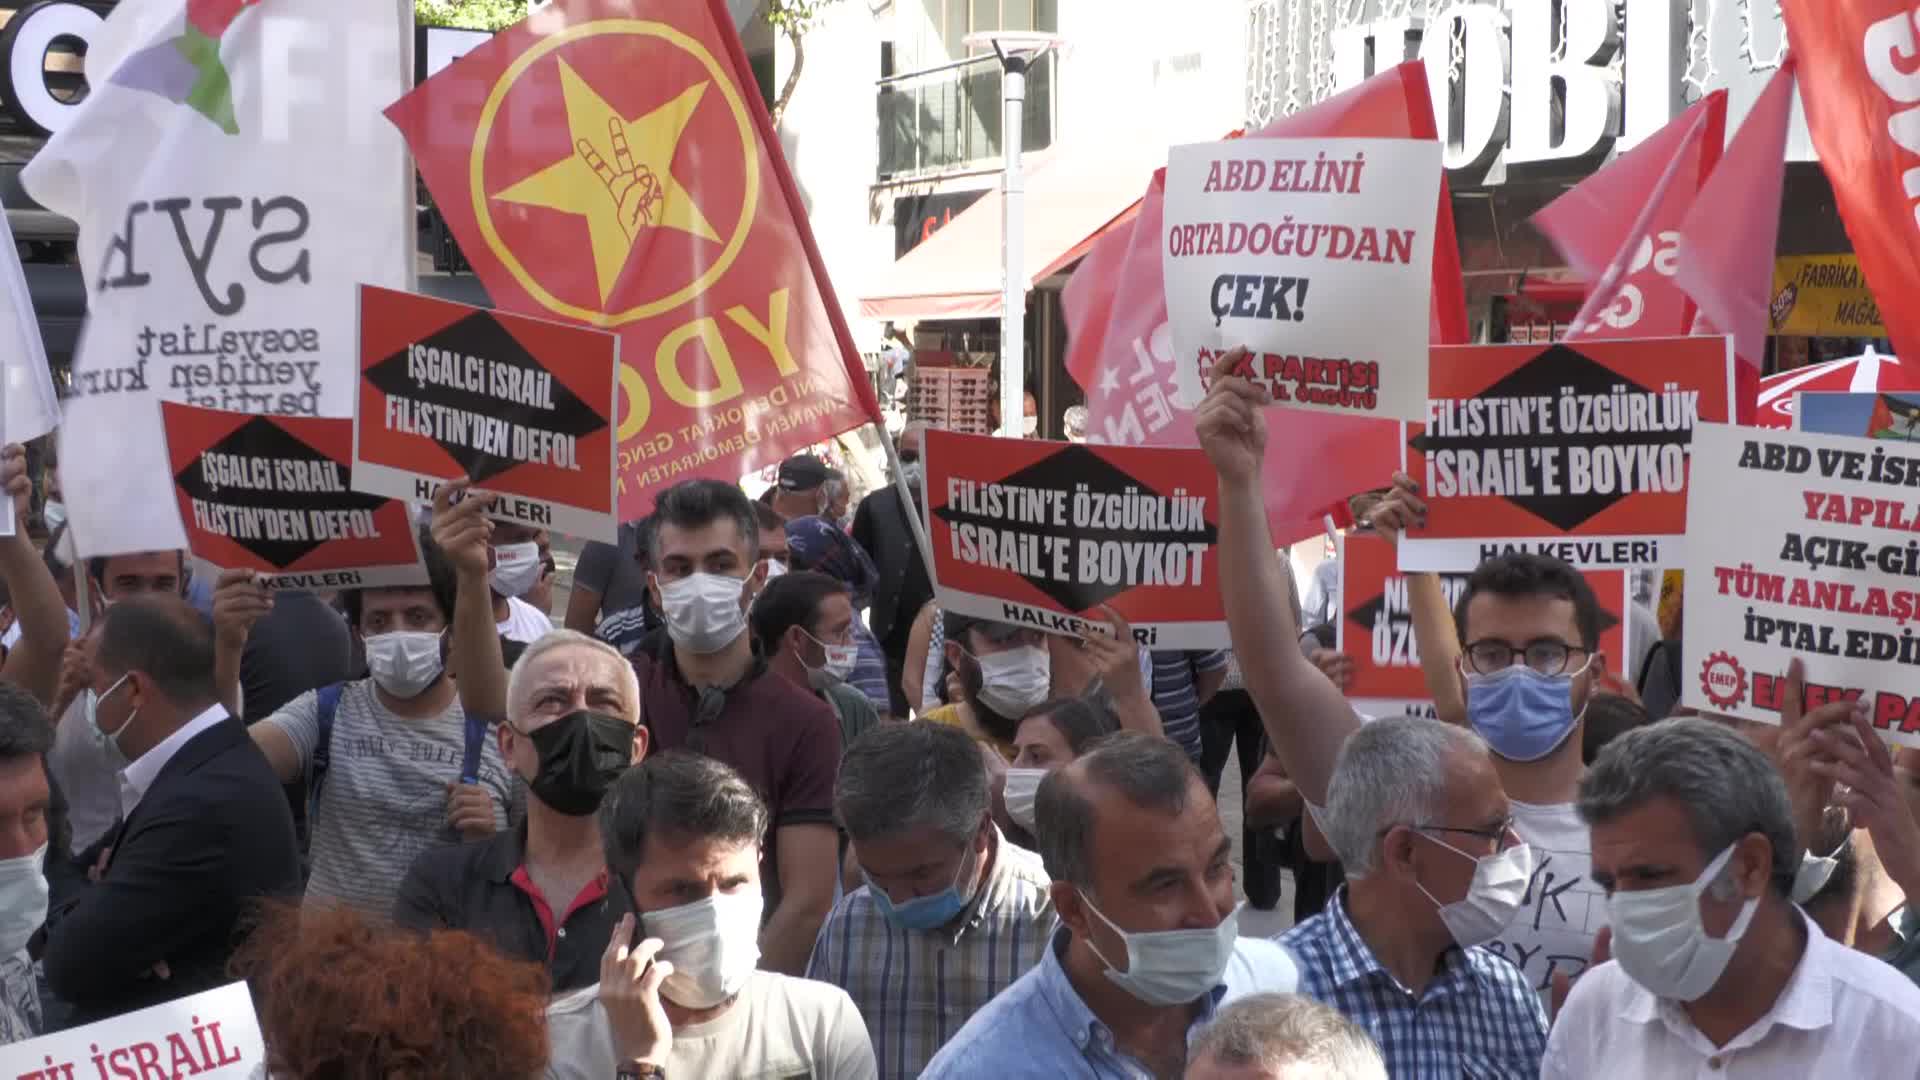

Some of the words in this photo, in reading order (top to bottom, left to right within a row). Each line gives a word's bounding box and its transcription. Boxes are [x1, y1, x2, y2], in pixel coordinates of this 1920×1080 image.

[1203, 159, 1266, 193] ABD
[1268, 152, 1365, 194] ELİNİ
[1169, 215, 1416, 264] ORTADOĞU'DAN
[1210, 274, 1309, 327] ÇEK!
[1560, 382, 1699, 434] ÖZGÜRLÜK
[512, 431, 581, 471] DEFOL
[1738, 440, 1812, 475] ABD
[1817, 448, 1866, 481] VE
[311, 507, 381, 540] DEFOL
[1073, 483, 1206, 532] ÖZGÜRLÜK
[1078, 540, 1209, 586] BOYKOT
[1714, 563, 1786, 602] TÜM
[1788, 577, 1920, 626] ANLAŞ
[1744, 607, 1840, 657] İPTAL
[1709, 671, 1737, 689] EMEP
